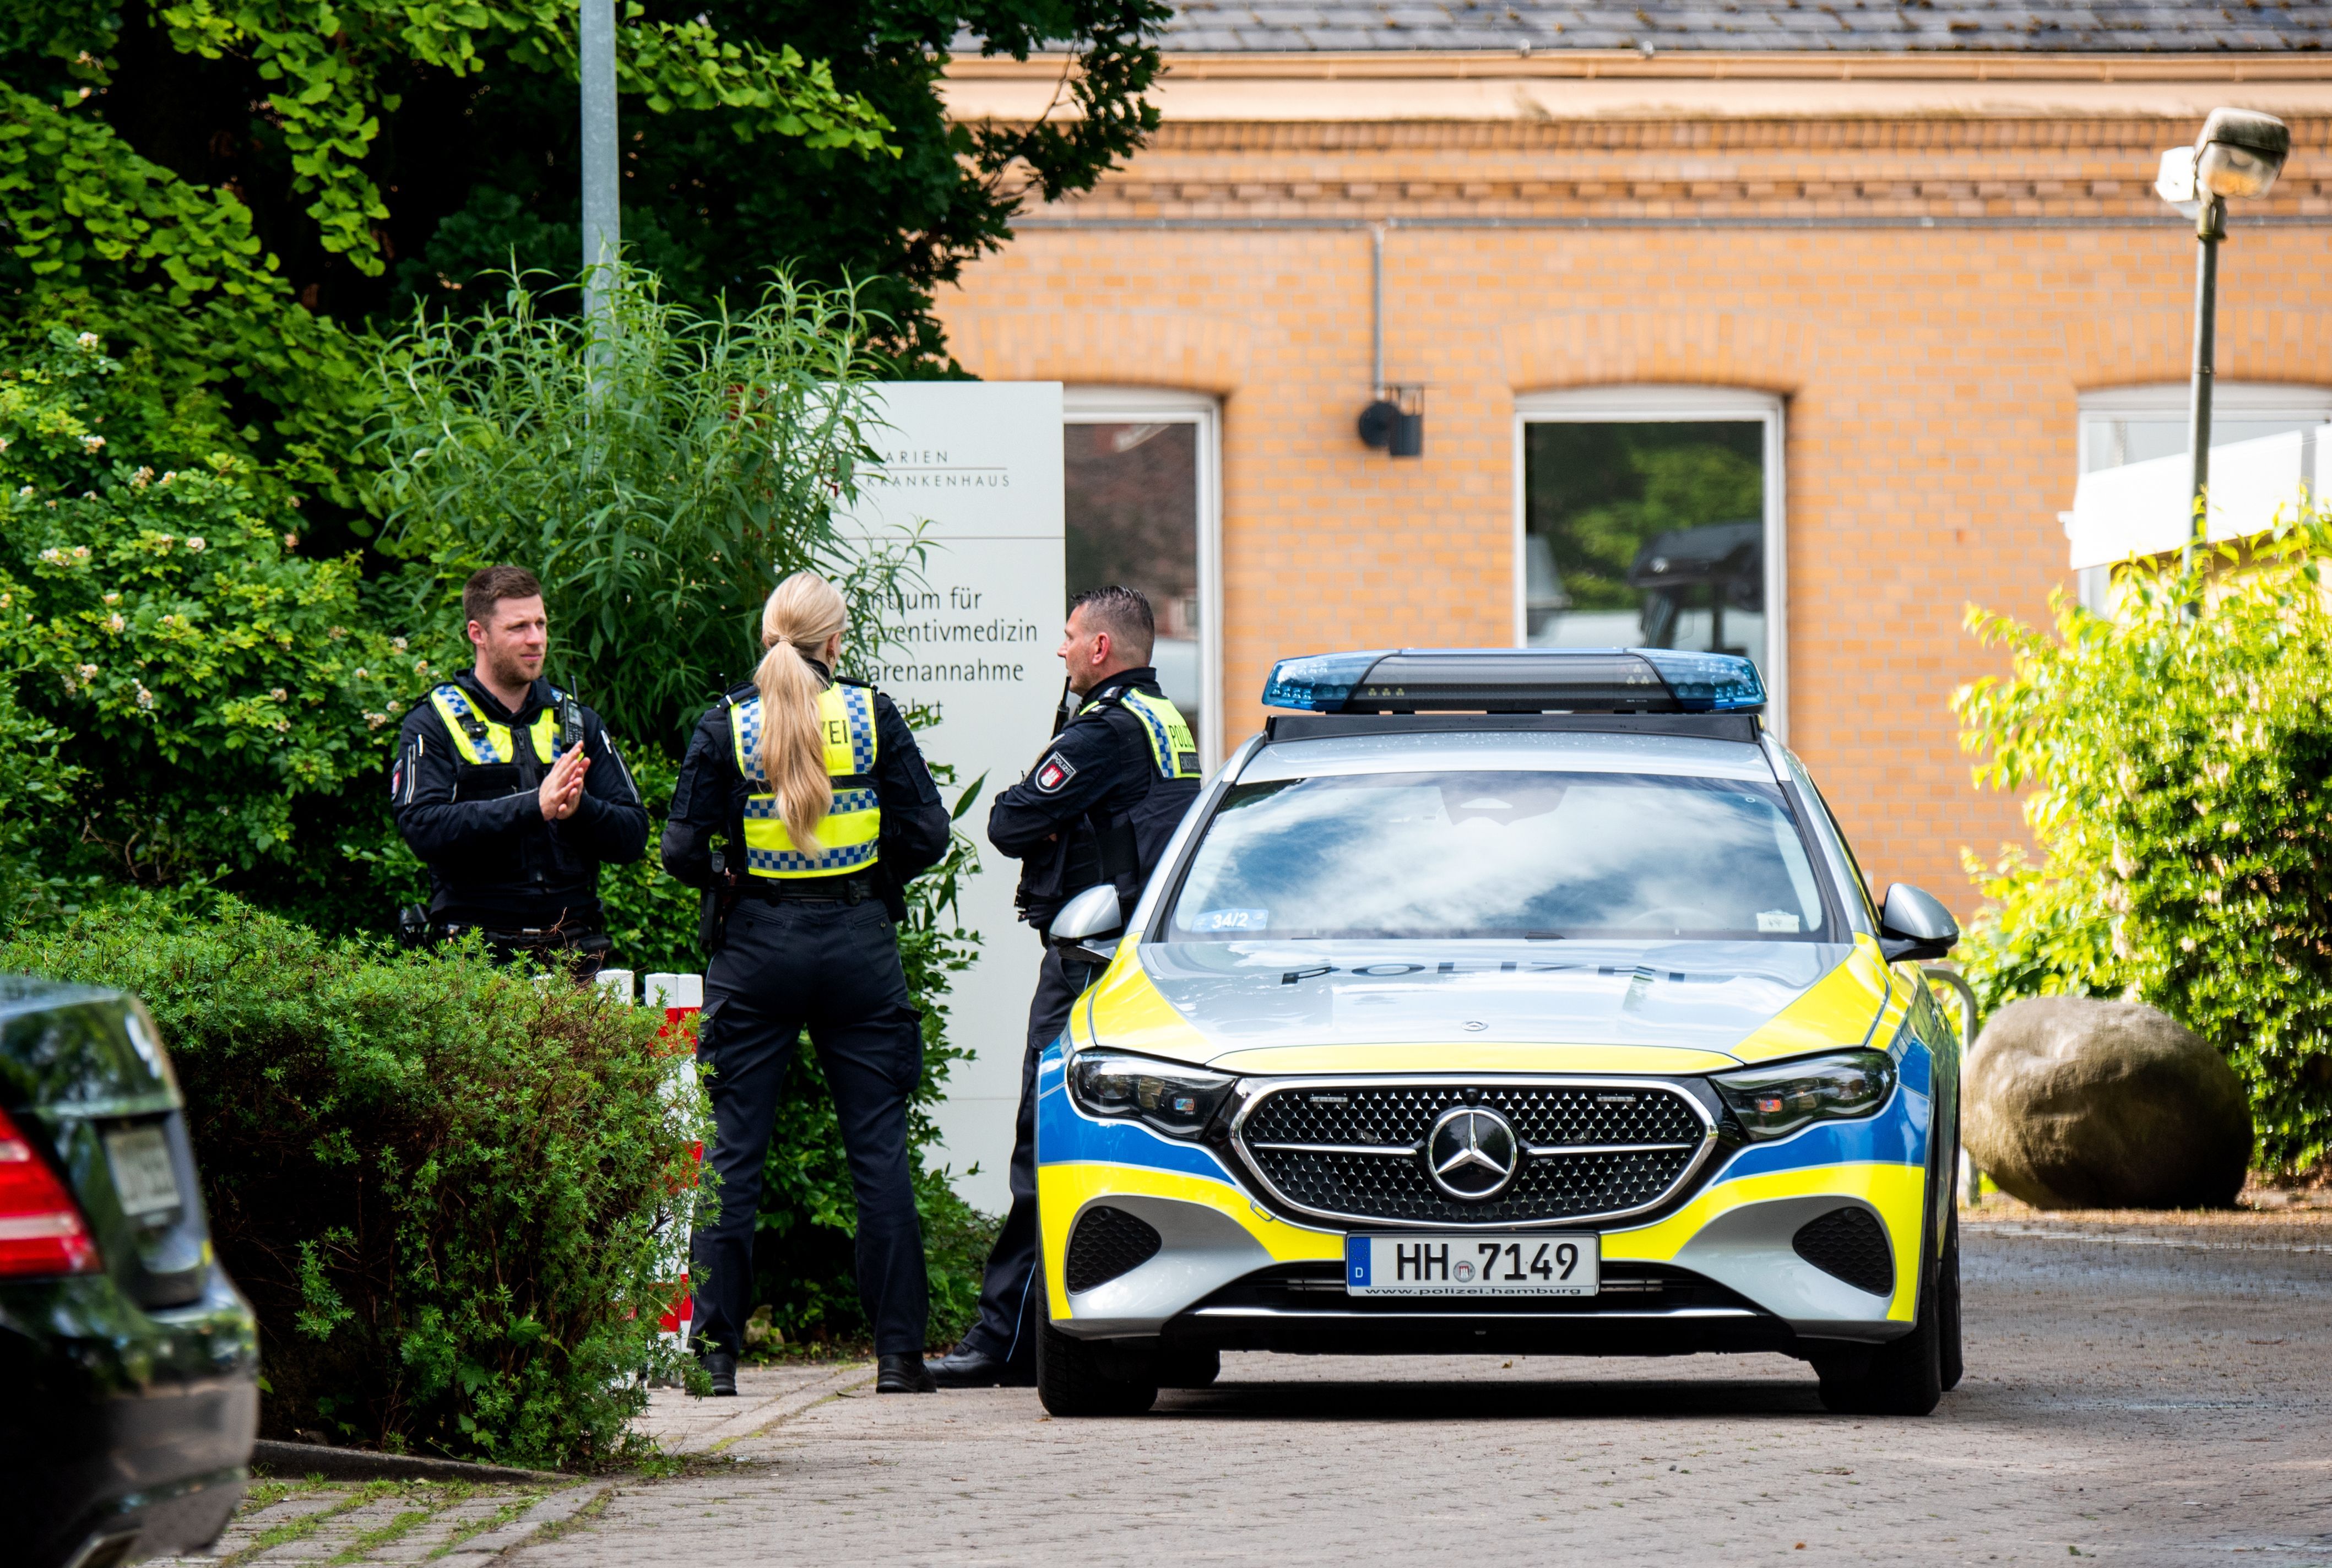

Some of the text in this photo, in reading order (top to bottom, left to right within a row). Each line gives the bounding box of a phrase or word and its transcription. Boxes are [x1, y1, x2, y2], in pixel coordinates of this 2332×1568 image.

[883, 451, 948, 464] ARIEN
[866, 474, 1010, 487] KRANKENHAUS
[865, 586, 982, 610] ntum für
[866, 618, 1037, 642] äventivmedizin
[1212, 911, 1249, 929] 34/2
[1397, 1243, 1579, 1281] HH 7149
[1355, 1267, 1363, 1278] D
